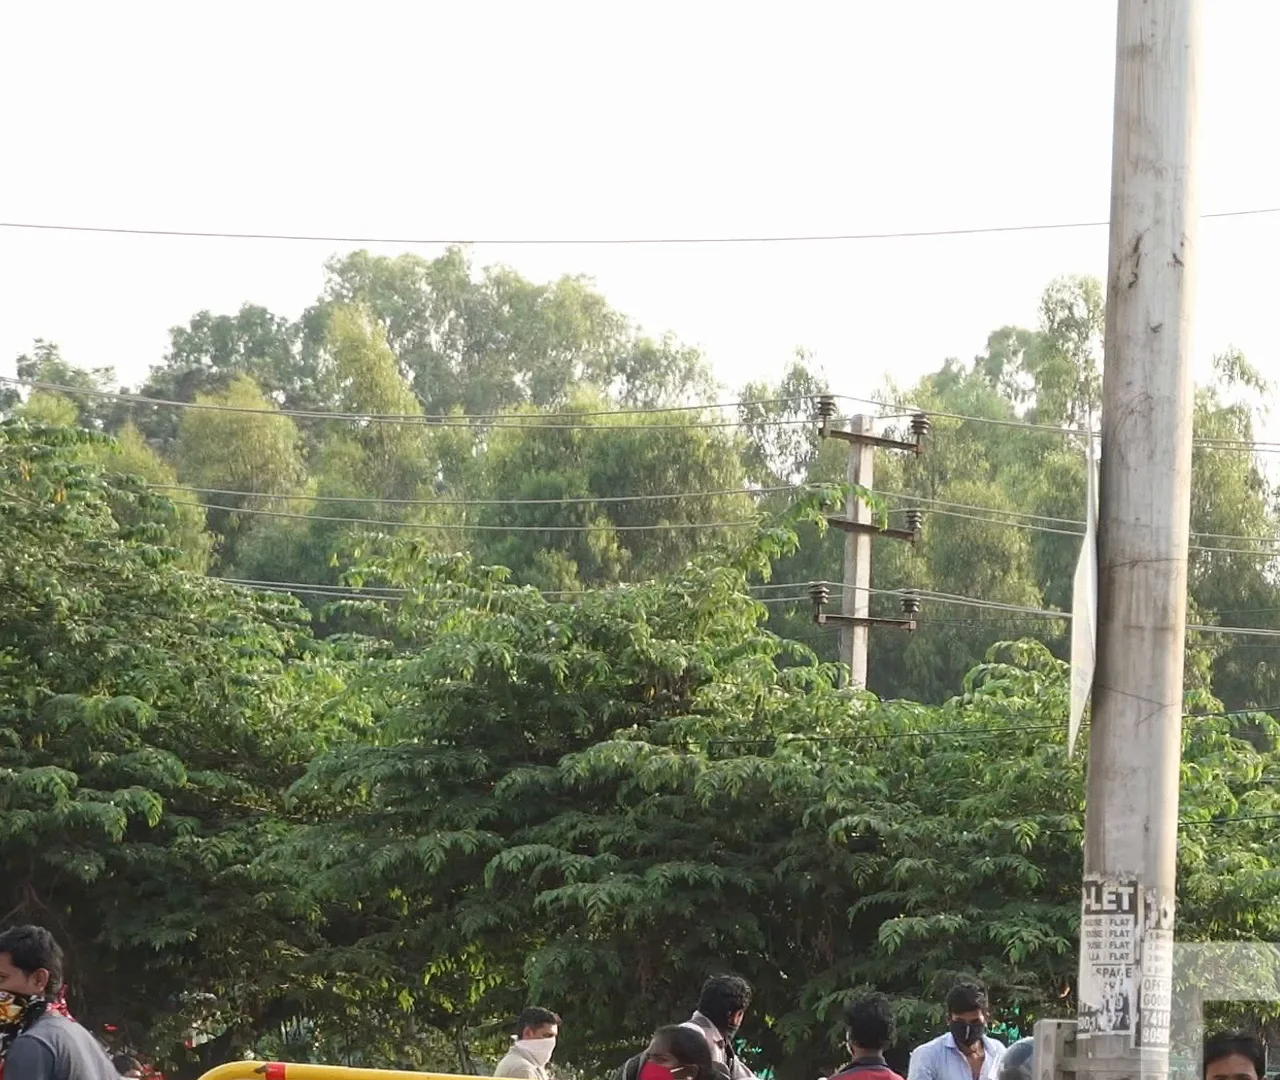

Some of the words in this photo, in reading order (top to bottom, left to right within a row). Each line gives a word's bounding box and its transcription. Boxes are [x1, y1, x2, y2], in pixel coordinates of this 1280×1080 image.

[1082, 887, 1134, 910] -LET
[1108, 930, 1130, 938] FLAT
[1108, 941, 1130, 949] FLAT
[1108, 952, 1130, 960] FLAT
